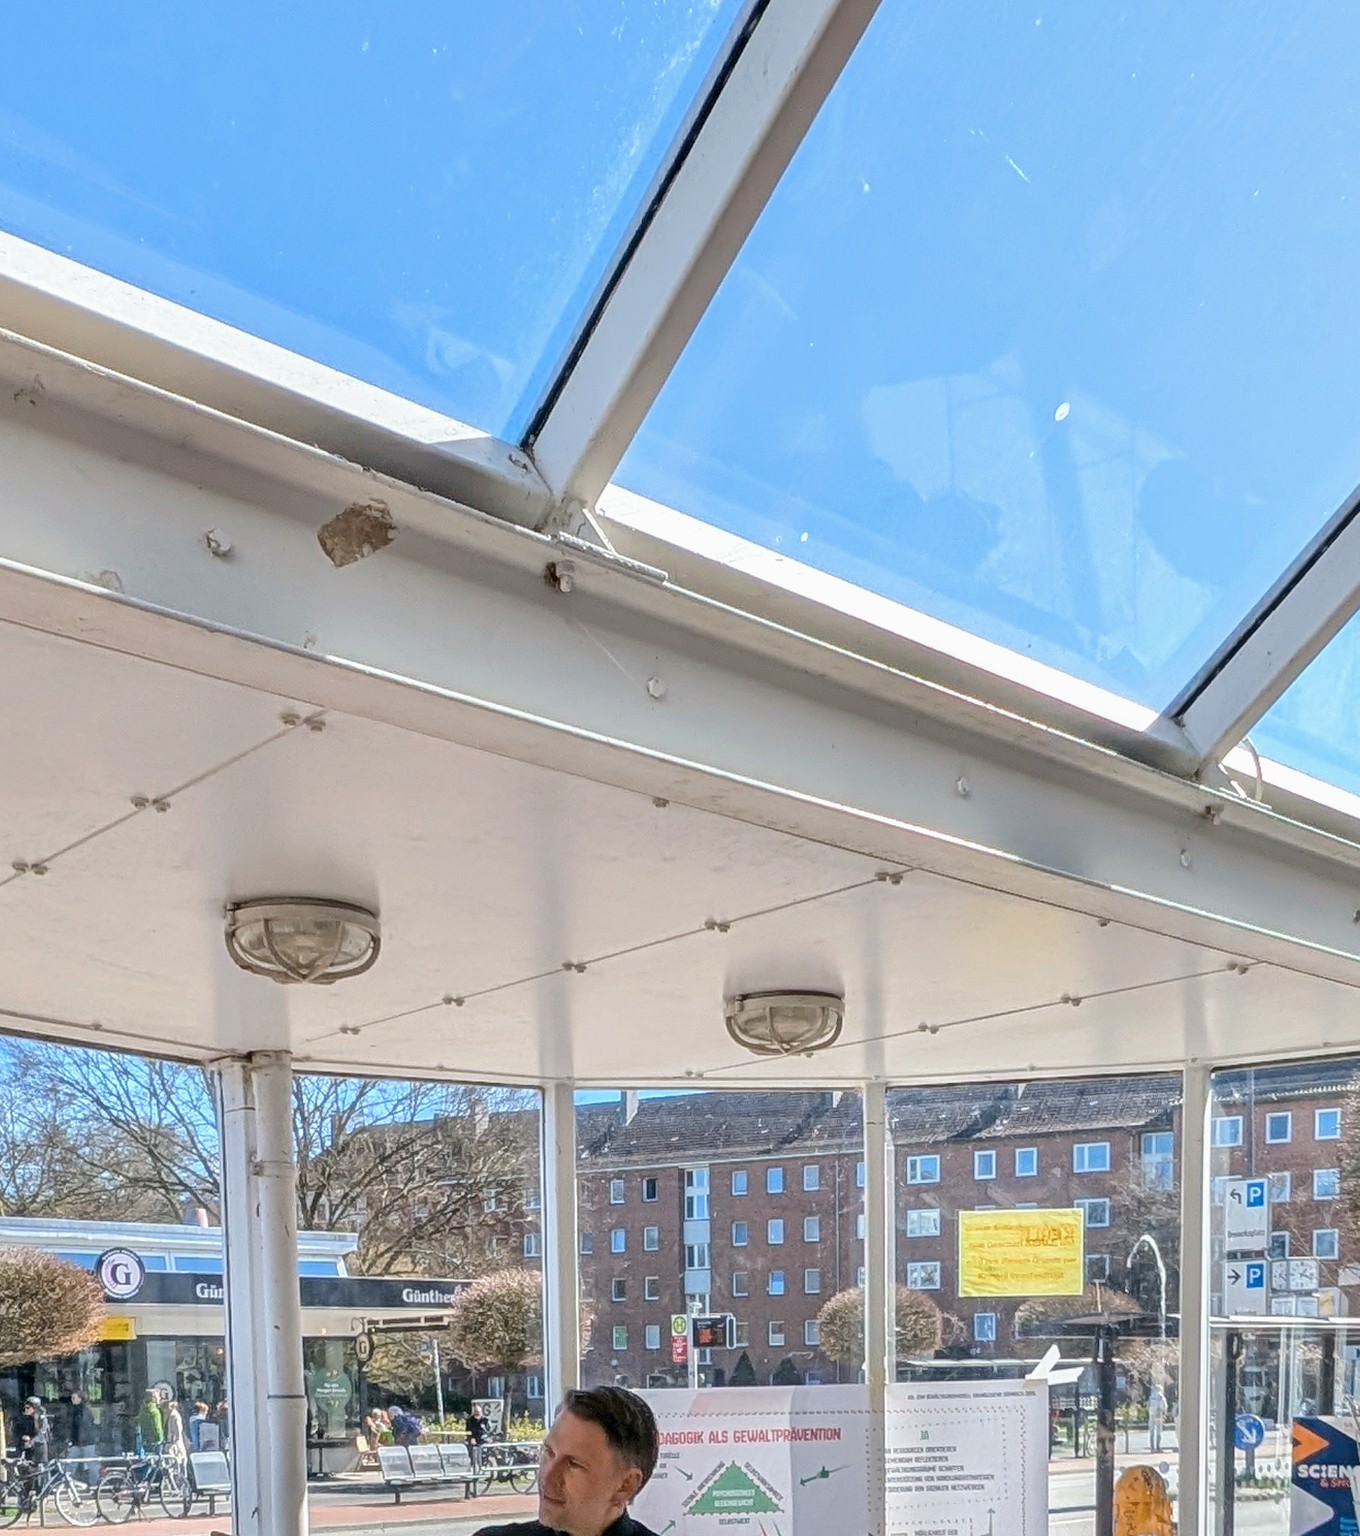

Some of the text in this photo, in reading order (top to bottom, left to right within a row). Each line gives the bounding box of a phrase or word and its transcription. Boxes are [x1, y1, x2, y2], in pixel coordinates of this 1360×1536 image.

[1249, 1186, 1262, 1203] P
[110, 1263, 132, 1285] G
[1249, 1267, 1261, 1284] P
[709, 1429, 729, 1444] ALS
[733, 1426, 842, 1444] GEWALTPRÄVENTION
